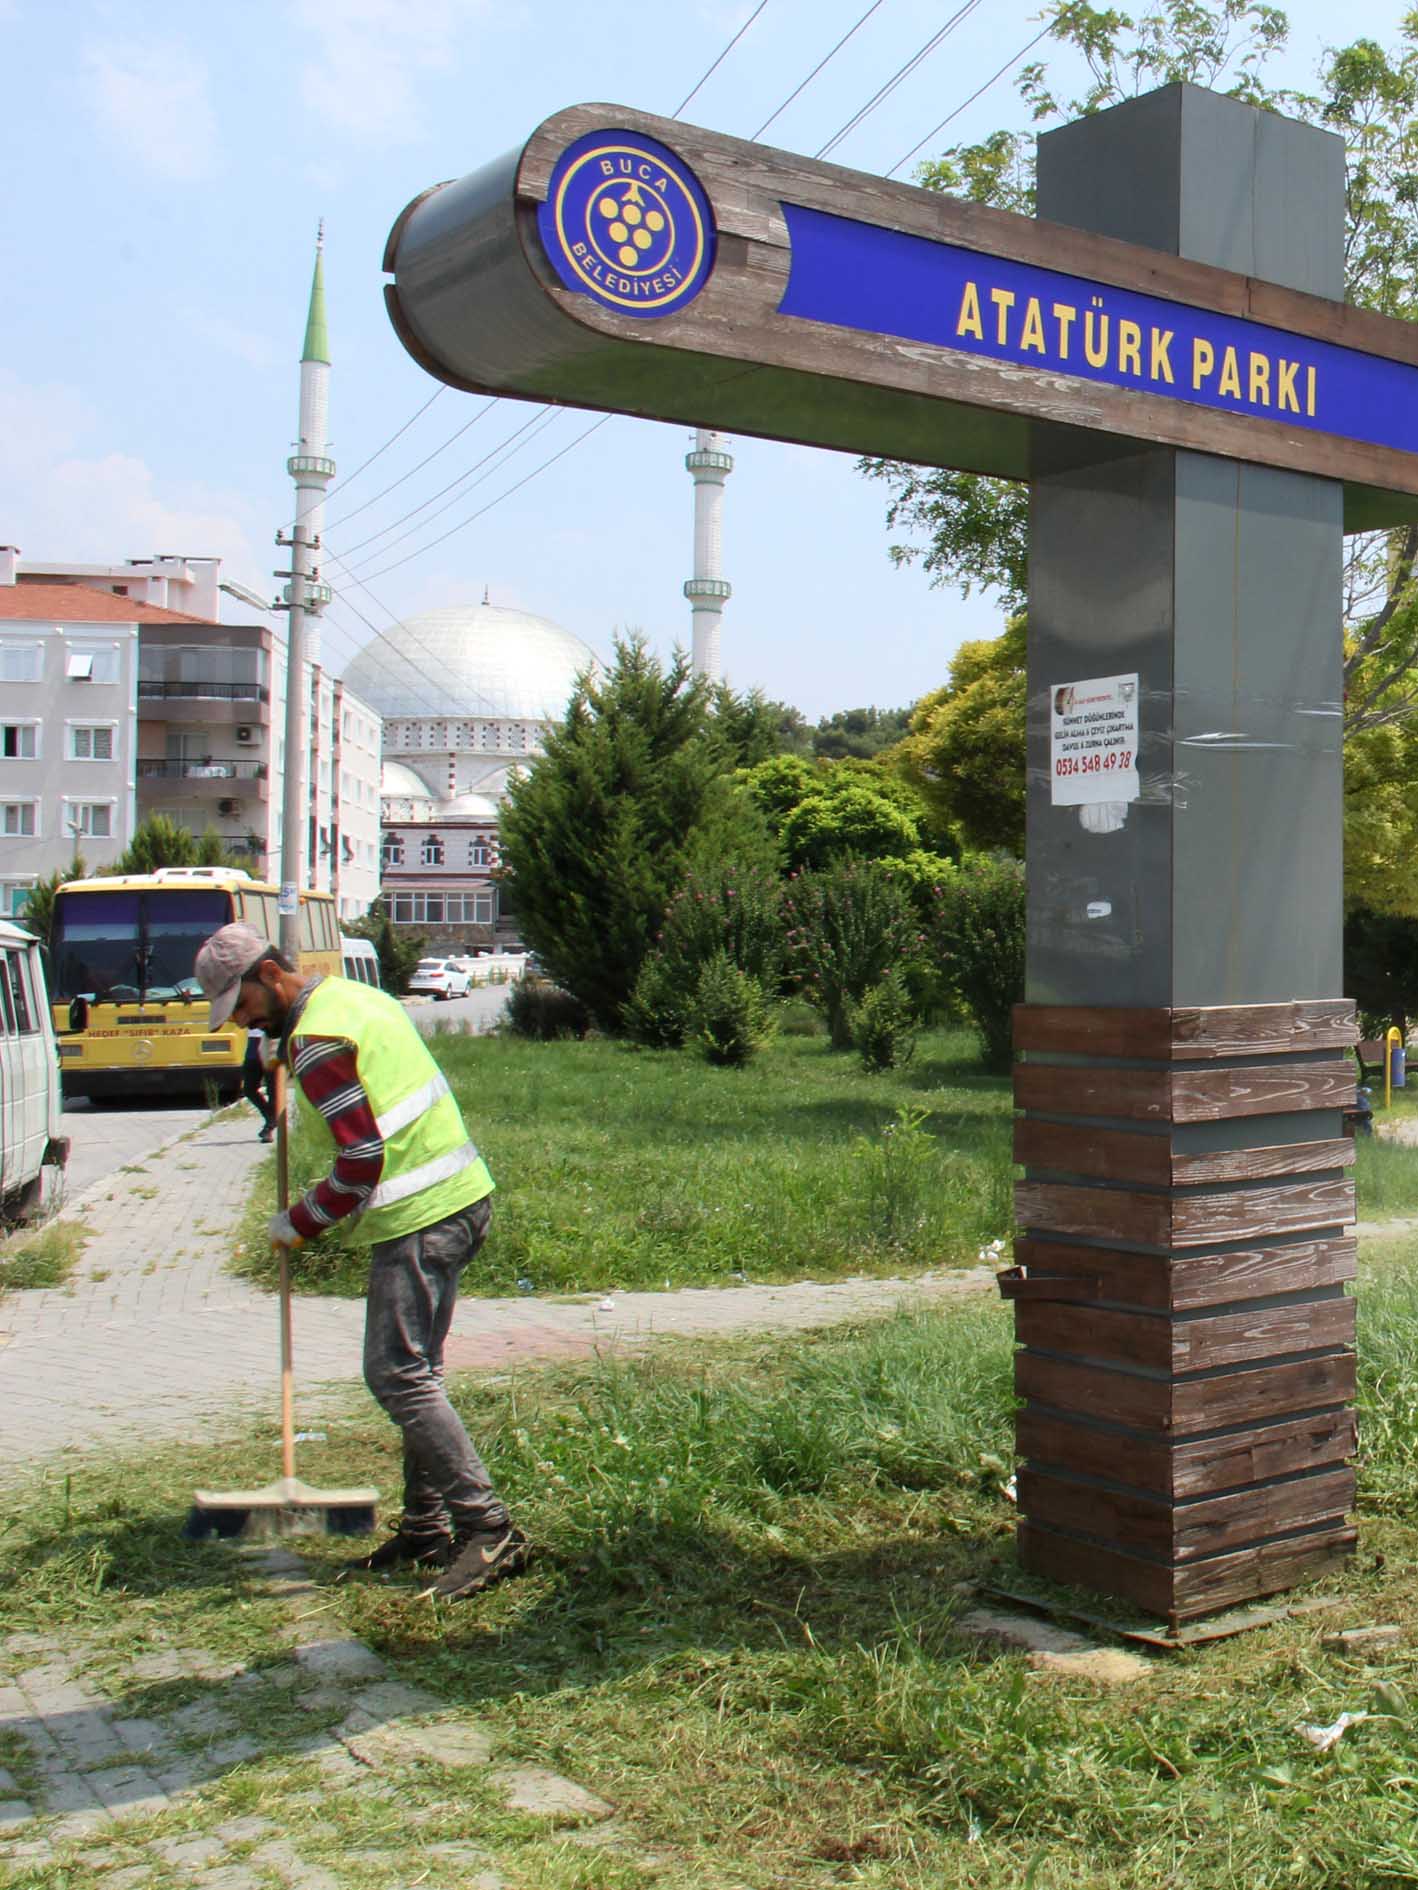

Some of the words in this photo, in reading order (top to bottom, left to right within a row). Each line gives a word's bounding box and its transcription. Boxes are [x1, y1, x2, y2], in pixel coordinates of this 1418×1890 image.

[600, 158, 668, 192] BUCA
[572, 242, 682, 295] BELEDİYESİ
[956, 282, 1174, 384] ATATÜRK
[1192, 337, 1316, 417] PARKI
[1056, 757, 1079, 776] 0534
[1082, 754, 1101, 773] 548
[1103, 752, 1117, 769] 49
[1119, 750, 1132, 769] 38
